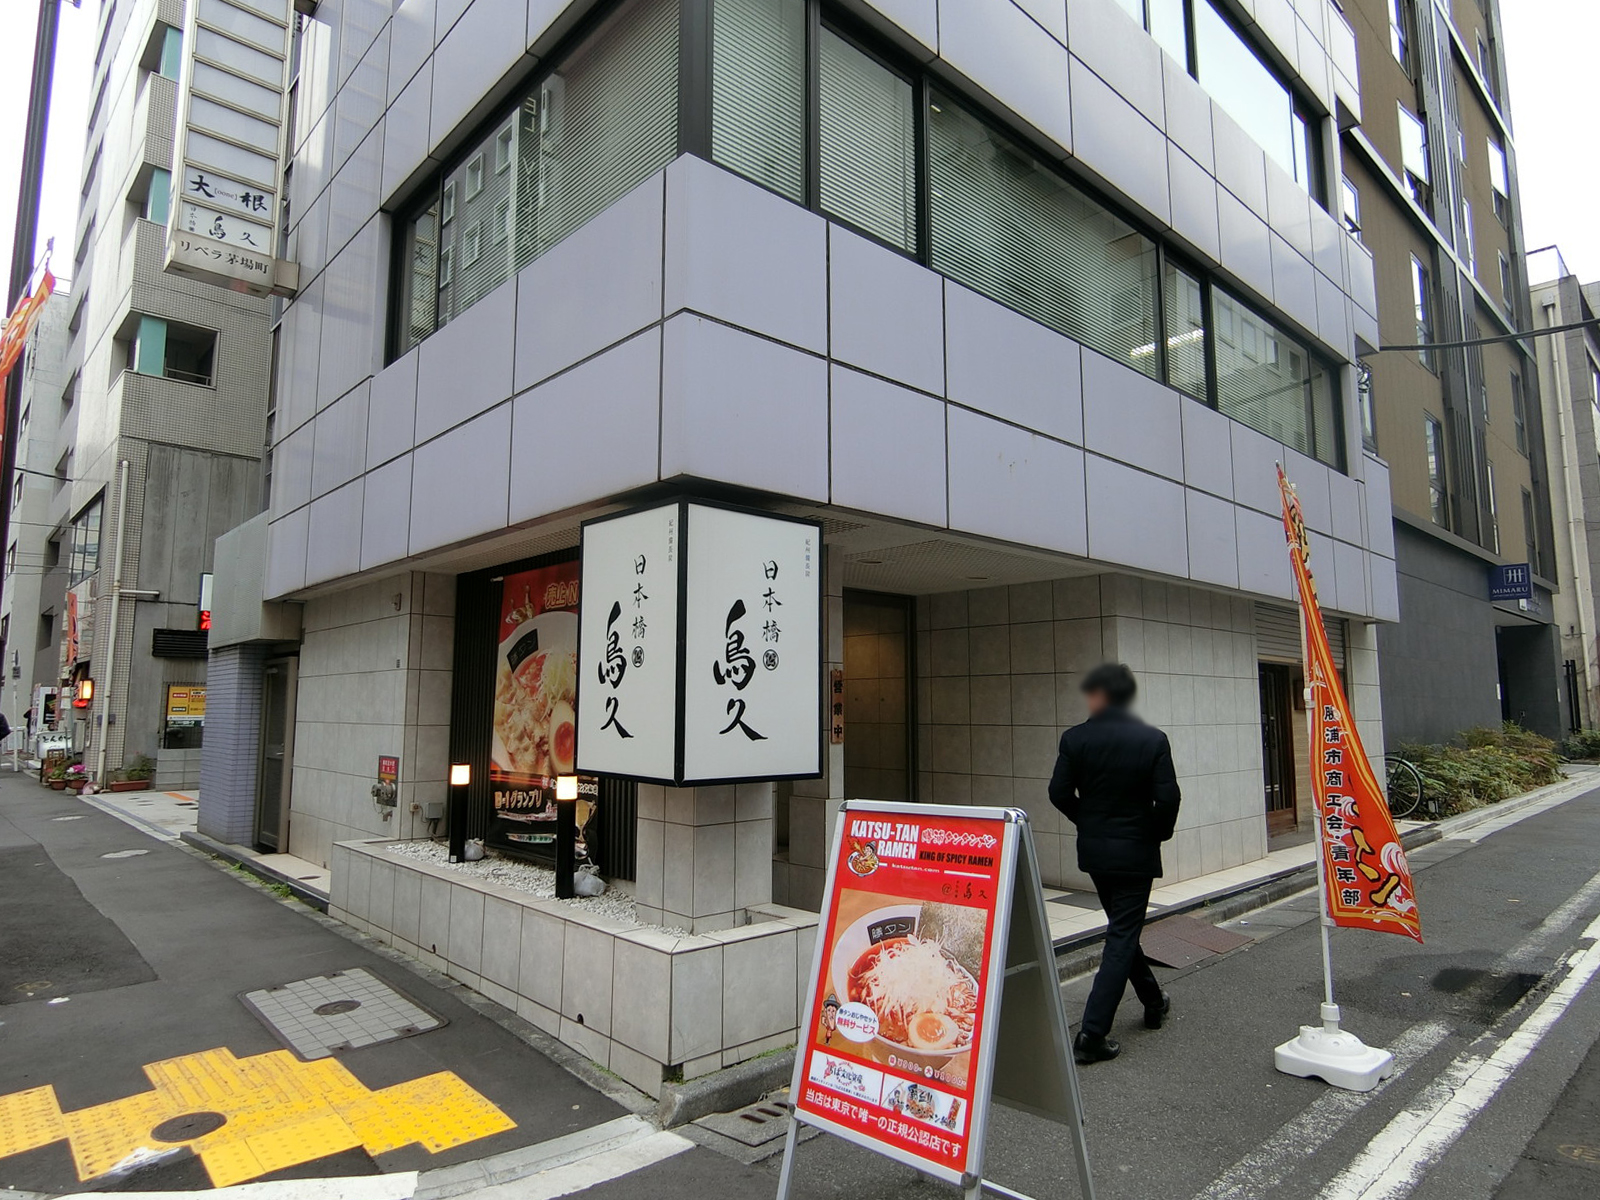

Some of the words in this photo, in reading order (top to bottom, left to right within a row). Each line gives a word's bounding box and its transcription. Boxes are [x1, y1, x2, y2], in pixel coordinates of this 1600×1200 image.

[631, 554, 649, 640] 日本橋
[761, 559, 783, 644] 日本橋
[850, 819, 920, 843] KATSU-TAN
[877, 841, 917, 860] RAMEN
[918, 851, 936, 862] KING
[936, 852, 946, 863] OF
[946, 854, 967, 865] SPICY
[968, 856, 994, 868] RAMEN
[836, 1016, 876, 1037] 無料サービス
[805, 1088, 963, 1158] 当店は東京で唯一の正規公認店です
